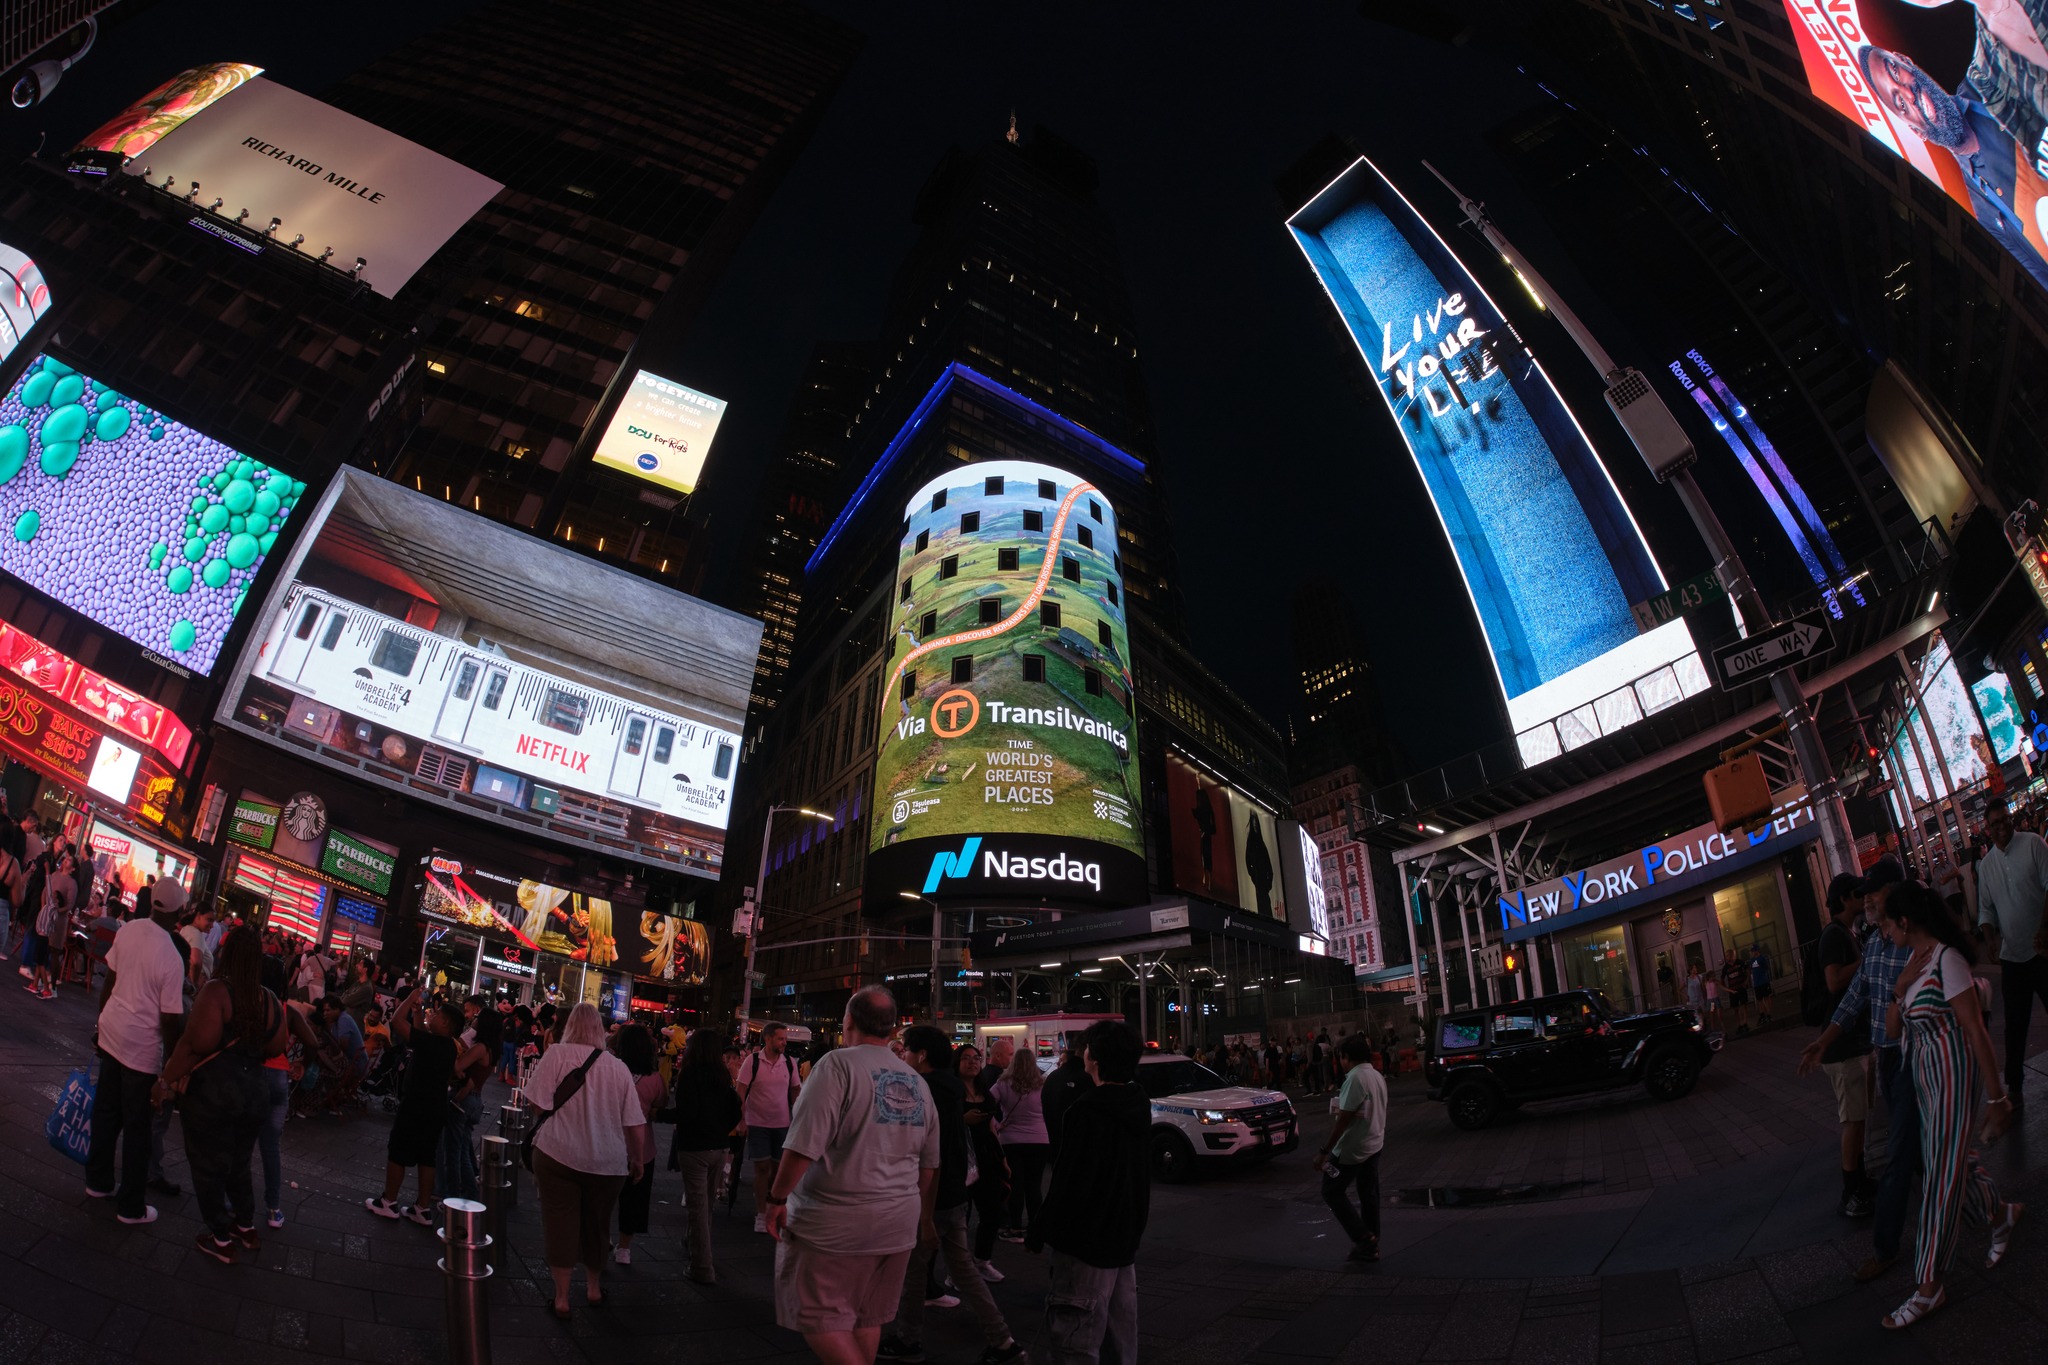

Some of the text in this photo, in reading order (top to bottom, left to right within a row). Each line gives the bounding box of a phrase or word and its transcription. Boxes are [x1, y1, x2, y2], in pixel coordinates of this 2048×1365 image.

[242, 136, 386, 205] RICHARD MILLE
[636, 374, 718, 411] TOGETHER
[661, 396, 675, 406] can
[678, 402, 701, 416] create
[628, 425, 688, 453] DCU for Kids
[1040, 554, 1054, 580] DISTANCE
[1035, 579, 1046, 597] LONG
[1654, 574, 1718, 620] W 43 St
[1025, 595, 1038, 612] FIRST
[955, 629, 992, 642] DISCOVER
[906, 638, 951, 661] TRANSILVANICA
[1734, 627, 1812, 672] ONE WAY
[355, 679, 396, 702] UMBRELLA
[389, 682, 404, 694] THE
[400, 689, 412, 706] 4
[363, 694, 402, 713] ACADEMY
[50, 714, 94, 748] BAKE
[897, 716, 926, 741] Via
[986, 701, 1128, 751] Transilvanica
[41, 731, 87, 764] SHOP
[1007, 739, 1033, 749] TIME
[516, 734, 591, 774] NETFLIX
[986, 752, 1053, 768] WORLD'S
[985, 769, 1053, 784] GREATEST
[676, 784, 714, 800] UMBRELLA
[706, 785, 719, 794] THE
[717, 789, 726, 804] 4
[984, 786, 1054, 805] PLACES
[686, 795, 719, 810] ACADEMY
[234, 806, 277, 827] STARBUCKS
[236, 822, 264, 838] COFFEE
[328, 838, 393, 875] STARBUCKS
[336, 858, 379, 884] COFFEE
[984, 851, 1101, 892] Nasdaq
[1499, 889, 1563, 930] NEW
[1561, 865, 1640, 911] YORK
[1641, 832, 1737, 885] POLICE
[1160, 917, 1180, 926] Turner
[1009, 933, 1035, 941] QUESTION
[58, 1100, 69, 1118] &
[1163, 1106, 1184, 1114] POLICE
[58, 1122, 91, 1156] FUN
